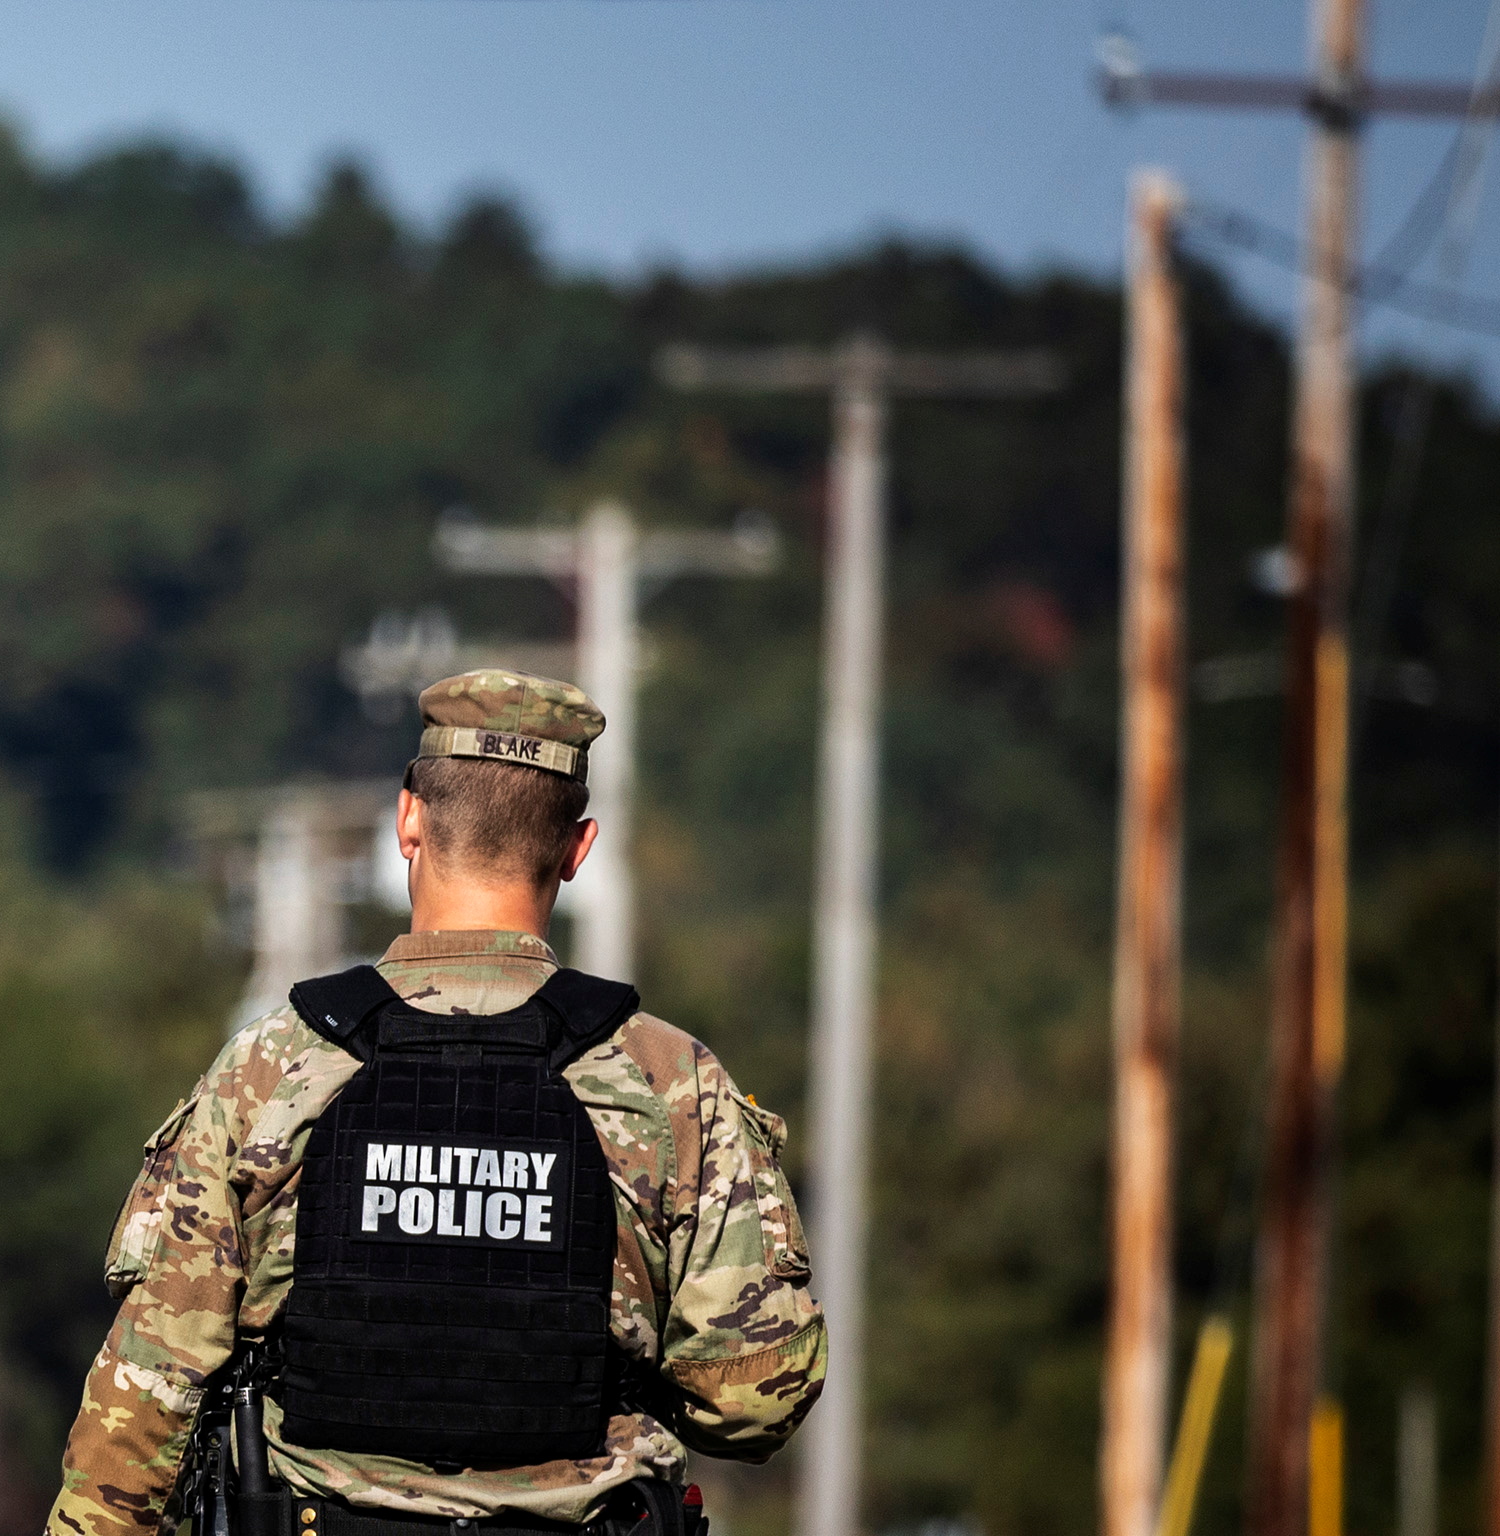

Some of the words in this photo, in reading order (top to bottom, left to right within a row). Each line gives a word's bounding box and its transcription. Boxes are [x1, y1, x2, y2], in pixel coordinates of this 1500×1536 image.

[484, 734, 542, 761] BLAKE
[365, 1143, 557, 1190] MILITARY
[361, 1185, 553, 1242] POLICE
